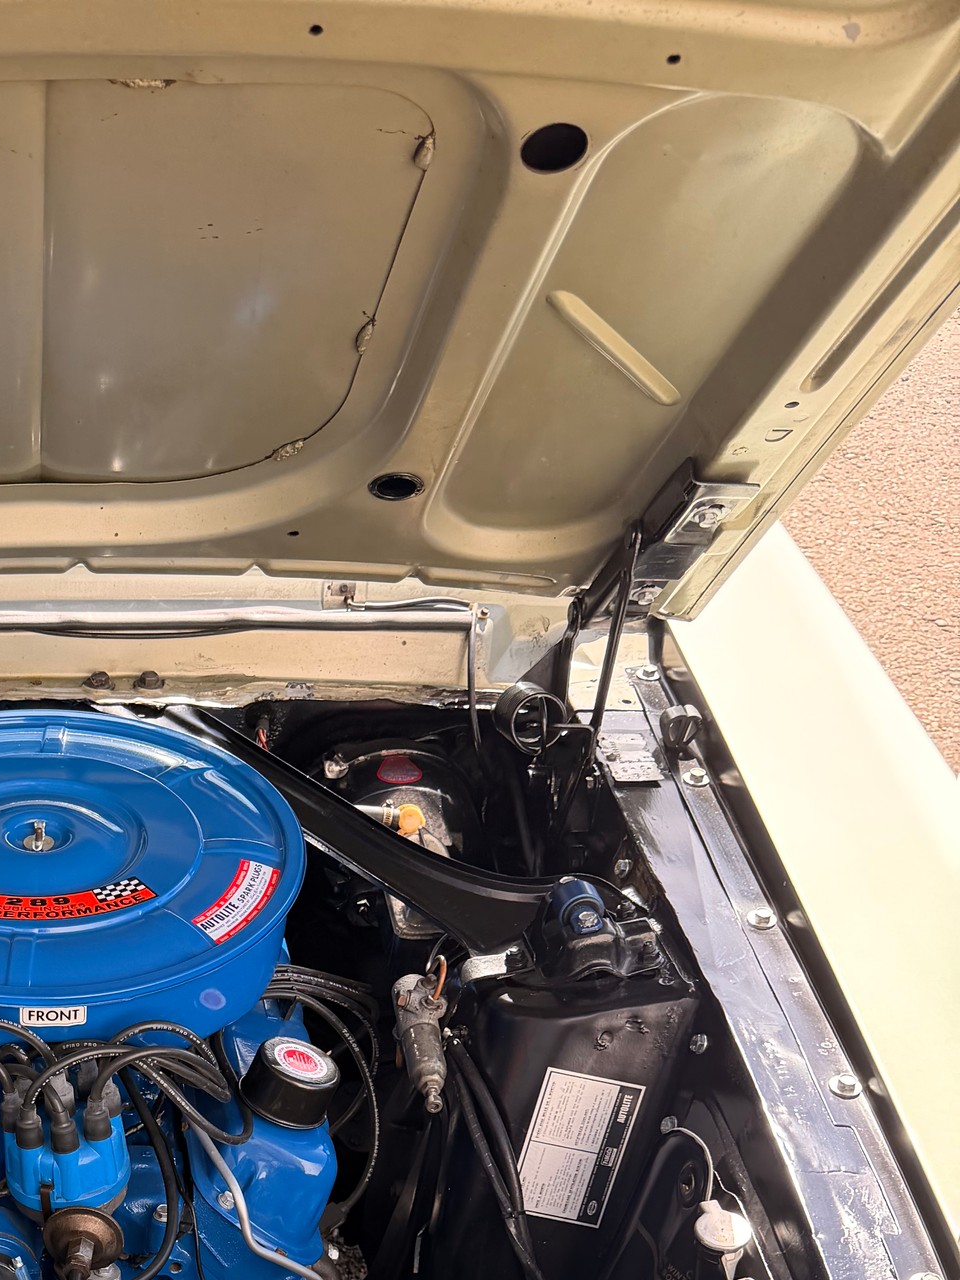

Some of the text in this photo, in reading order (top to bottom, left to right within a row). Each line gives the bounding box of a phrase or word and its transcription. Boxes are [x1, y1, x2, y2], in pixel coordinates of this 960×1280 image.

[5, 897, 71, 907] 289
[200, 901, 240, 931] AUTOLITE
[237, 881, 255, 904] SPARK
[250, 863, 263, 884] PLUGS
[40, 902, 85, 912] INCHES
[28, 1008, 80, 1023] FRONT
[342, 1028, 360, 1052] TAYLOR
[617, 1094, 633, 1124] AUTOLITE
